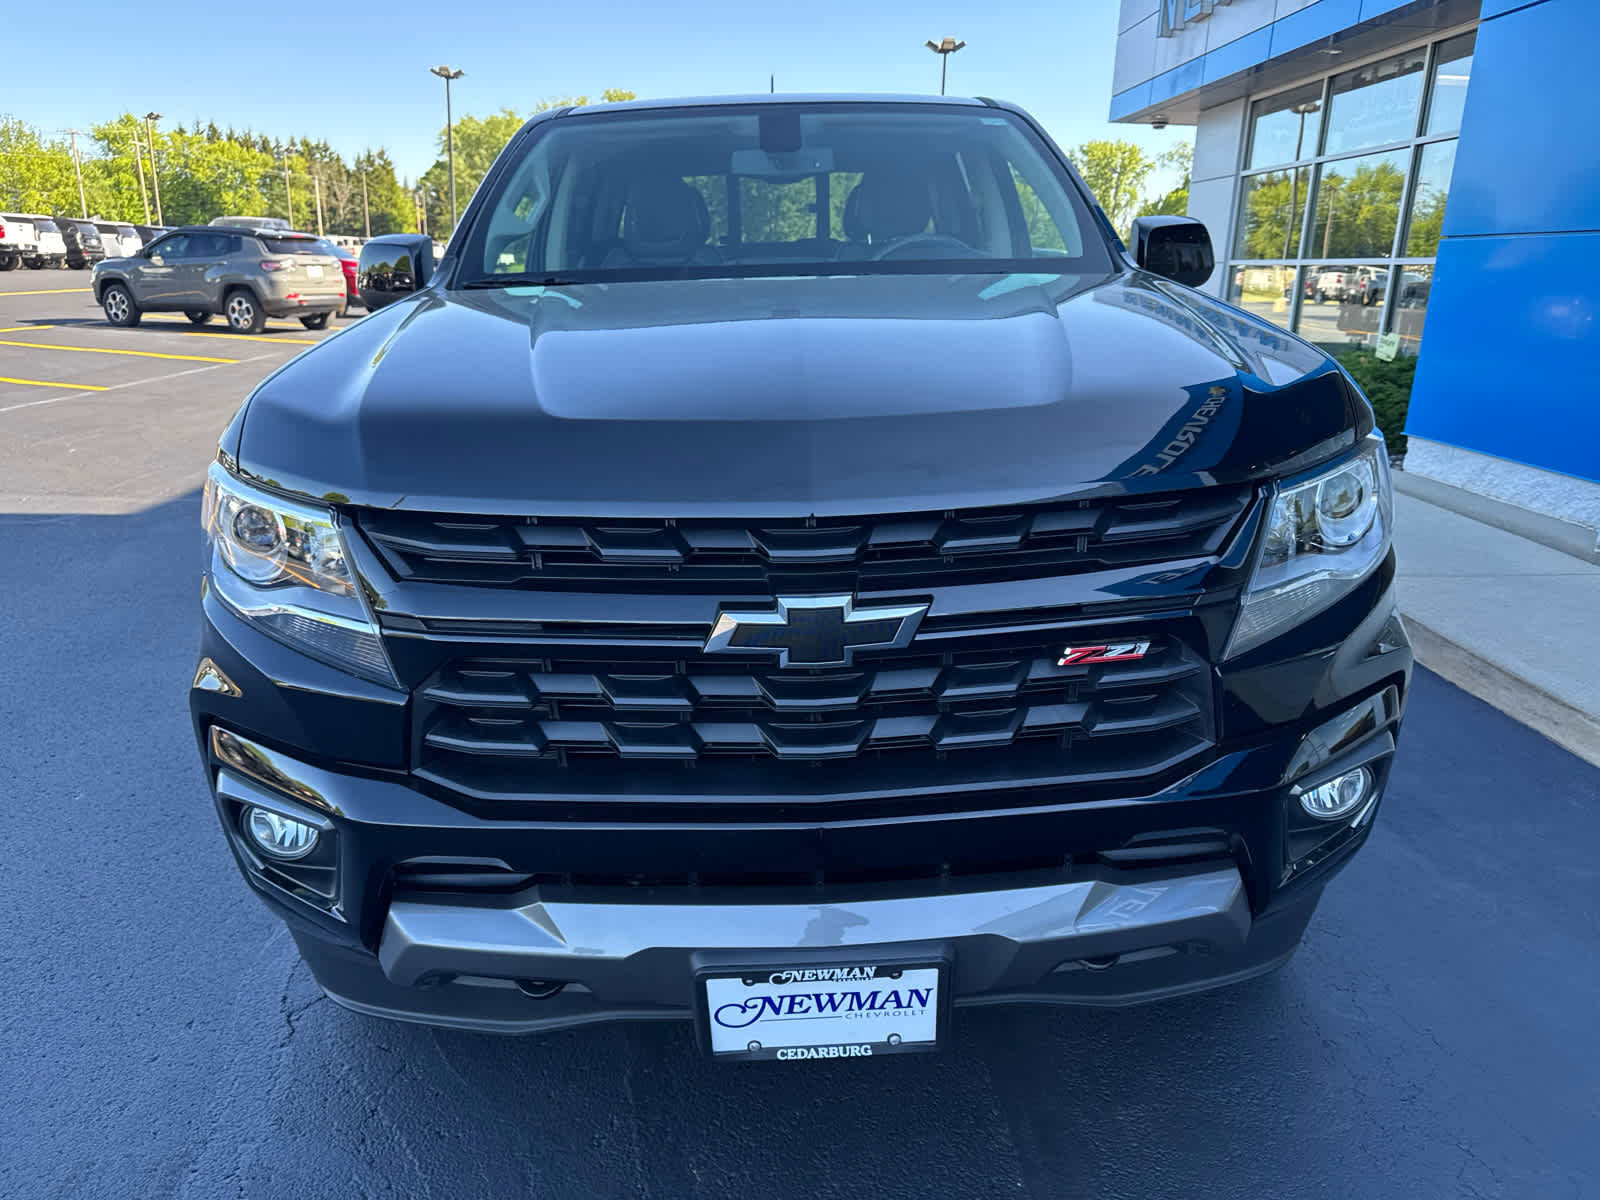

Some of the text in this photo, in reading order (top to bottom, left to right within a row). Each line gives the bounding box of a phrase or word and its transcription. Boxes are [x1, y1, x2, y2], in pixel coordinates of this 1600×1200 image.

[1057, 642, 1150, 666] Z71
[769, 966, 877, 985] NEWMAN
[714, 988, 934, 1029] NEWMAN
[844, 1009, 928, 1020] CHEVROLET
[776, 1045, 873, 1060] CEDARBURG
